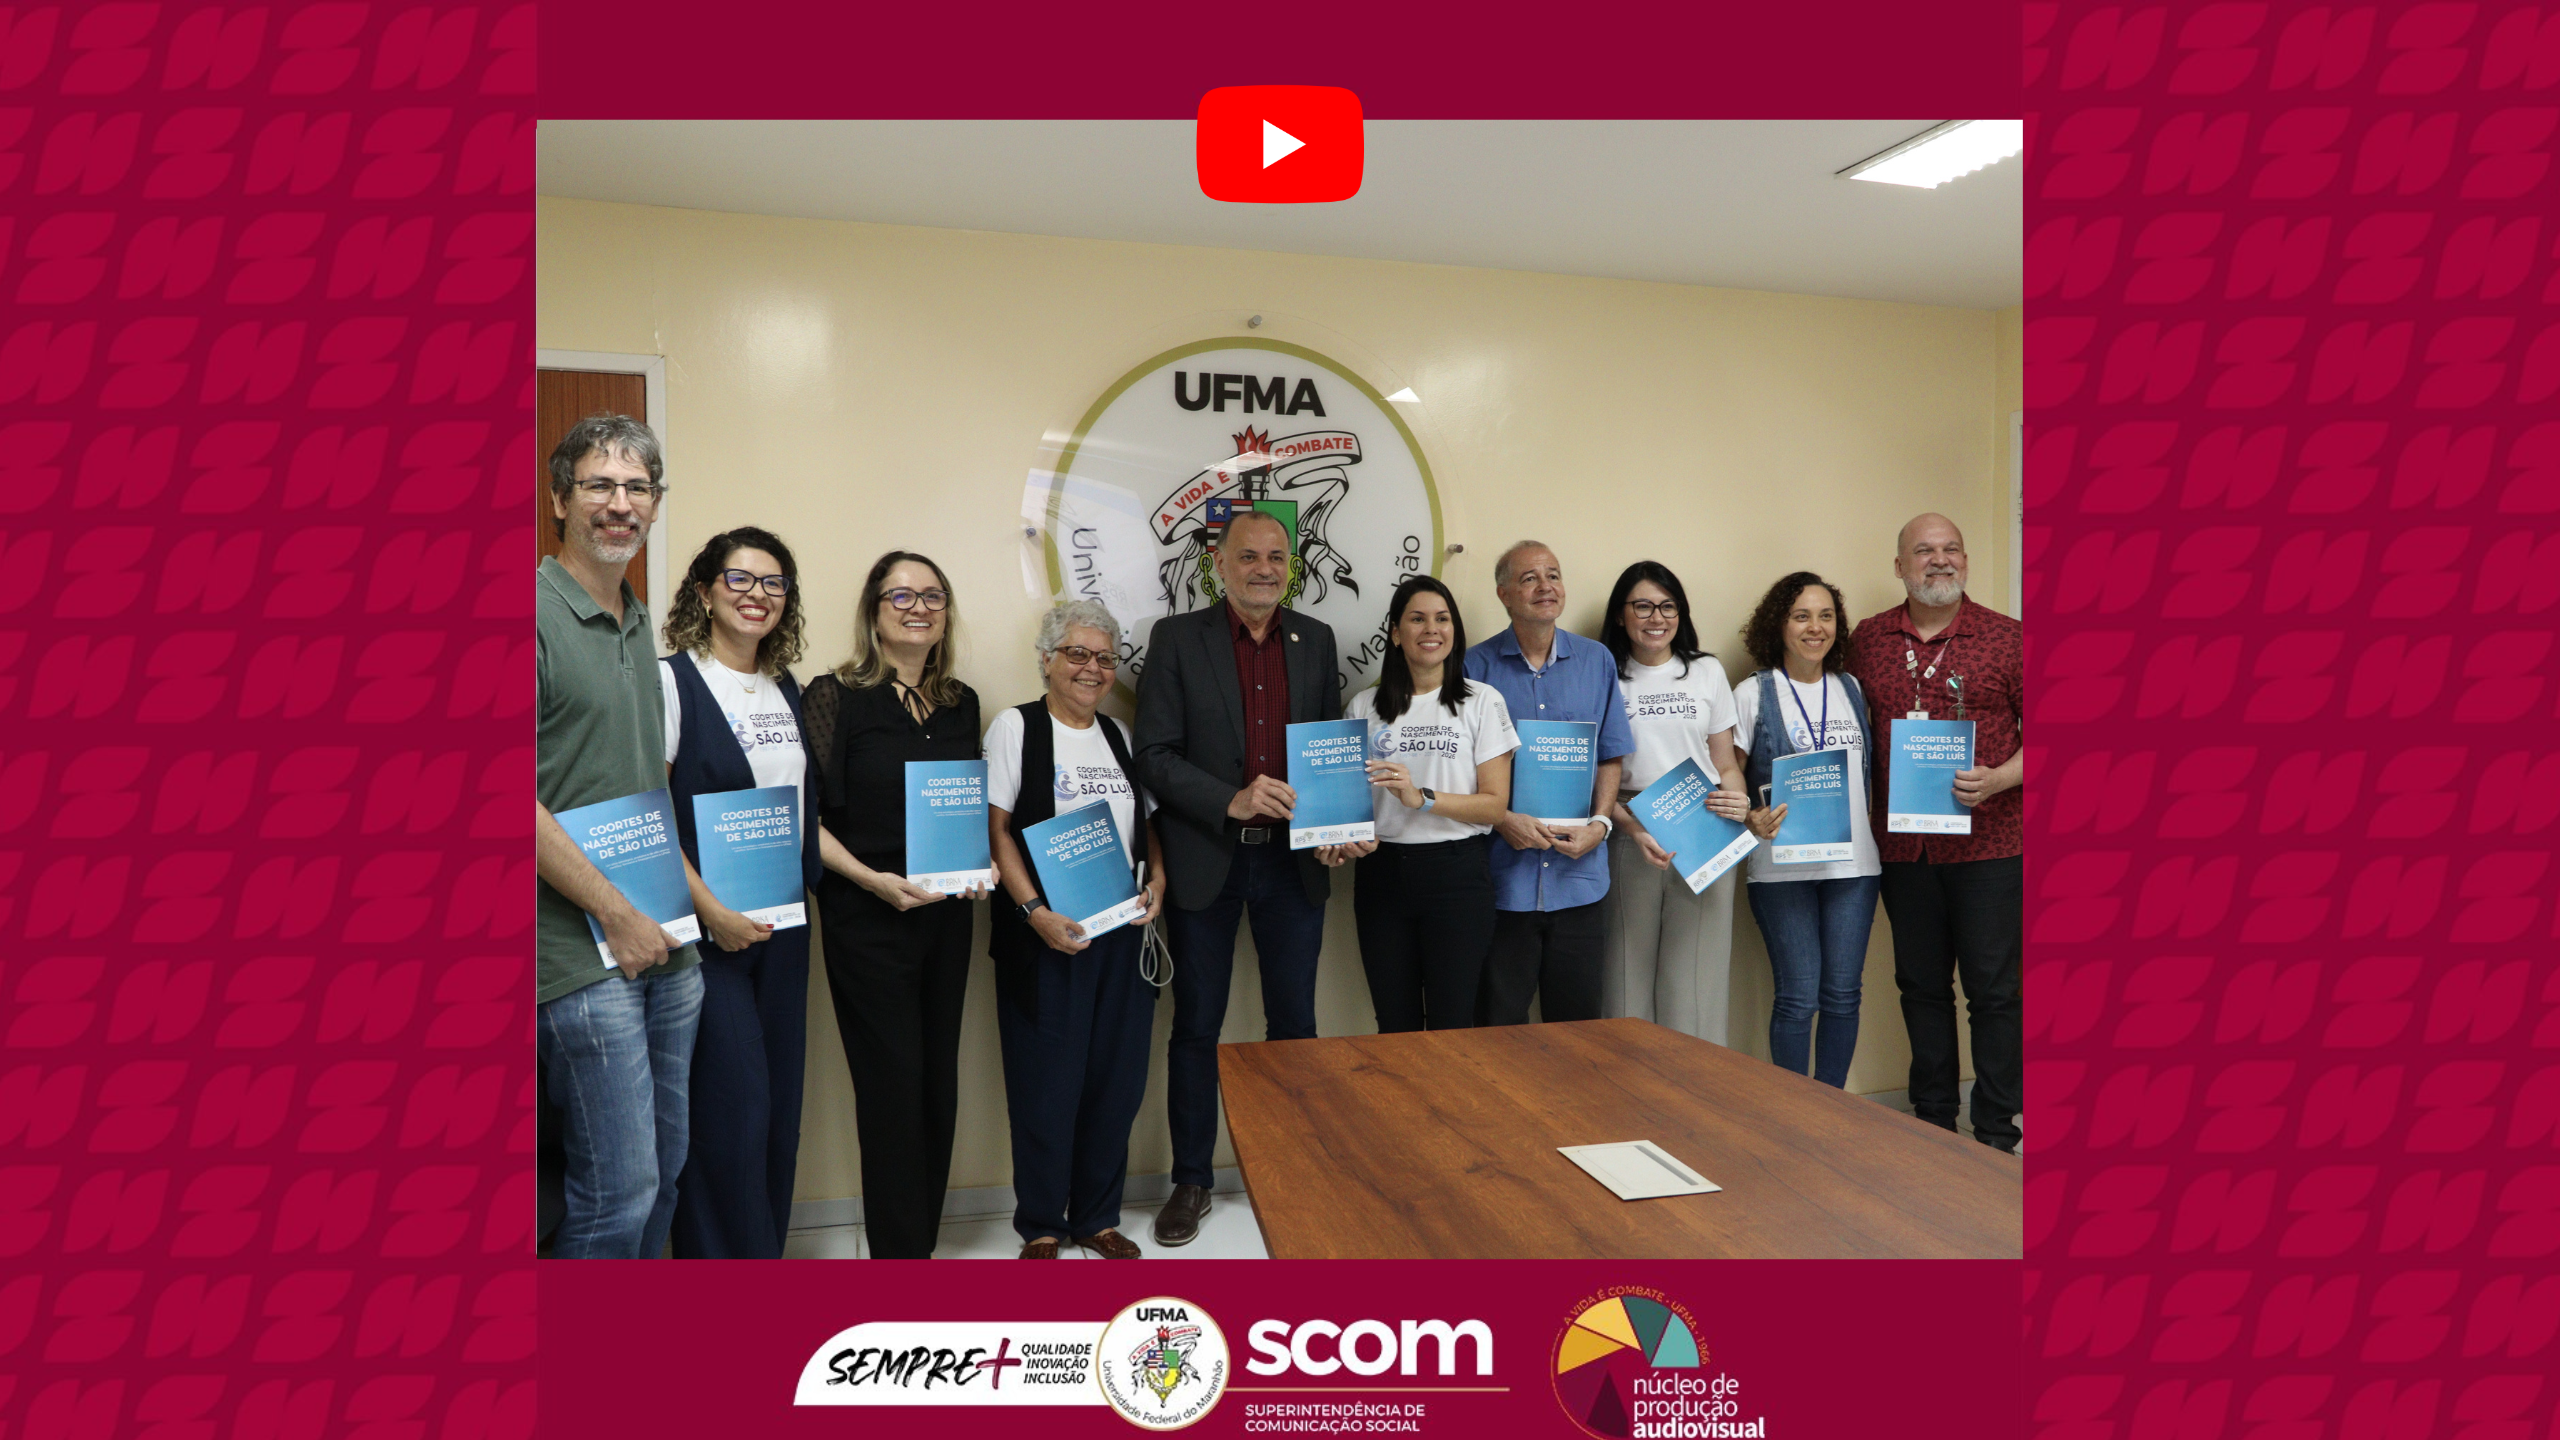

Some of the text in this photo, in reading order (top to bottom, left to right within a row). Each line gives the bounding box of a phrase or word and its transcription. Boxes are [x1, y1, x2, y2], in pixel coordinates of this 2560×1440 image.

[1175, 371, 1326, 417] UFMA
[1161, 512, 1174, 527] A
[1174, 481, 1214, 510] VIDA
[1275, 438, 1353, 459] COMBATE
[1639, 703, 1696, 715] SÃO LUÍS
[756, 730, 783, 745] SÃO
[1309, 737, 1347, 747] COORTES
[1840, 733, 1861, 744] LUÍS
[1302, 745, 1362, 757] NASCIMENTOS
[1399, 739, 1458, 753] SÃO LUÍS
[1311, 753, 1362, 766] DE SÃO LUÍS
[1570, 754, 1588, 762] LUÍS
[1927, 752, 1944, 760] SÃO
[1947, 752, 1965, 760] LUÍS
[1791, 766, 1826, 777] COORTES
[928, 778, 967, 786] COORTES
[1785, 773, 1841, 786] NASCIMENTOS
[1805, 782, 1821, 790] SÃO
[1823, 780, 1841, 788] LUÍS
[921, 787, 981, 797] NASCIMENTOS
[1081, 782, 1132, 794] SÃO LUÍ
[1652, 773, 1697, 808] COORTES DE
[931, 795, 981, 807] DE SÃO LUÍS
[1652, 780, 1702, 819] NASCIMENTOS
[722, 806, 790, 821] COORTES DE
[1664, 810, 1676, 820] DE
[1675, 799, 1690, 812] SÃO
[589, 810, 662, 836] COORTES DE
[714, 816, 790, 833] NASCIMENTOS
[583, 822, 664, 851] NASCIMENTOS
[726, 826, 791, 842] DE SÃO LUÍS
[1050, 819, 1107, 844] COORTES DE
[599, 847, 615, 859] DE
[618, 841, 640, 854] SÃO
[642, 833, 667, 847] LUÍS
[1046, 827, 1110, 856] NASCIMENTOS
[1059, 851, 1072, 861] DE
[1073, 844, 1091, 856] SÃO
[1093, 835, 1113, 848] LUÍS
